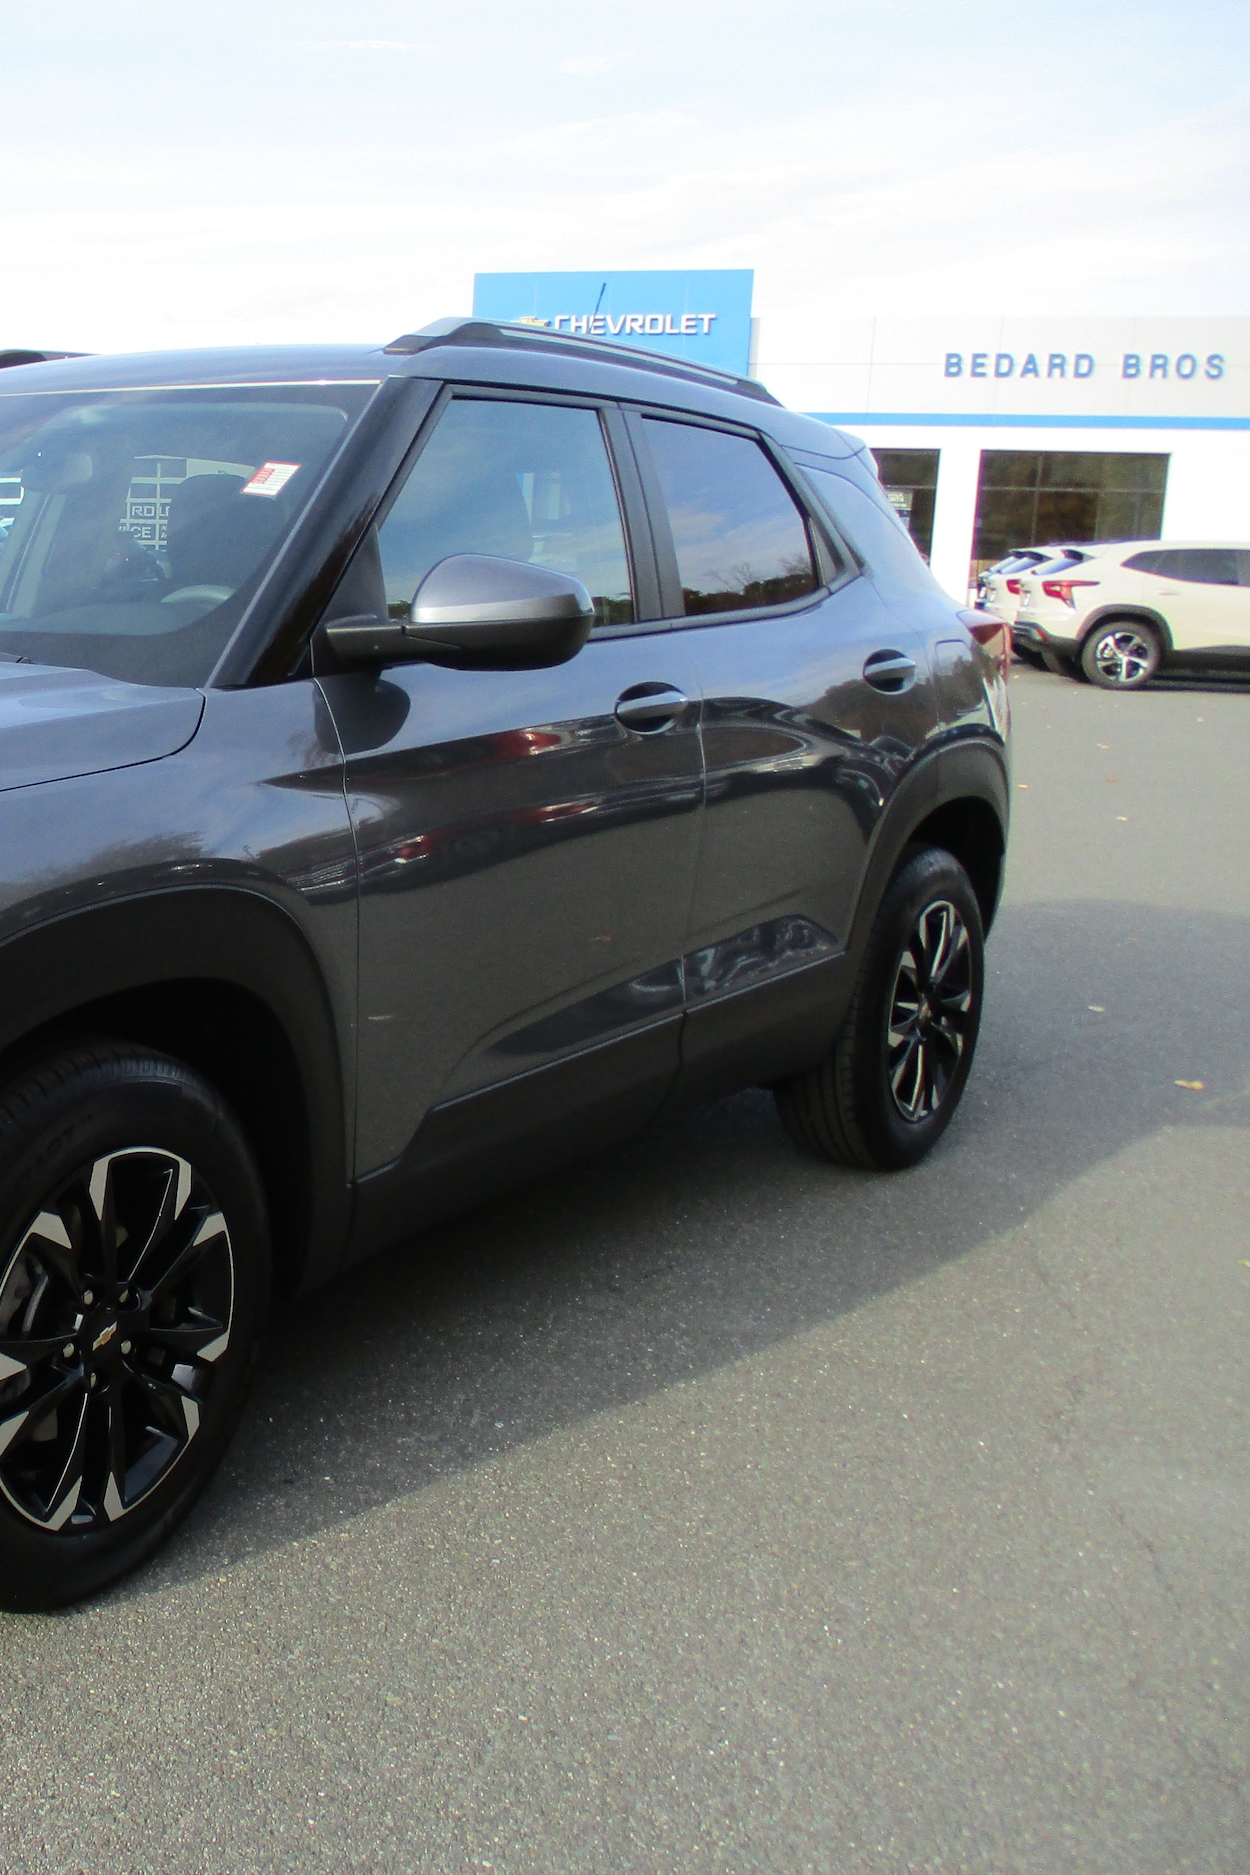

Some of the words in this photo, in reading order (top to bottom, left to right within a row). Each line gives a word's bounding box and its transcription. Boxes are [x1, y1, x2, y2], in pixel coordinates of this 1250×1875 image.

[554, 313, 717, 335] CHEVROLET
[944, 353, 1096, 378] BEDARD
[1122, 353, 1226, 380] BROS
